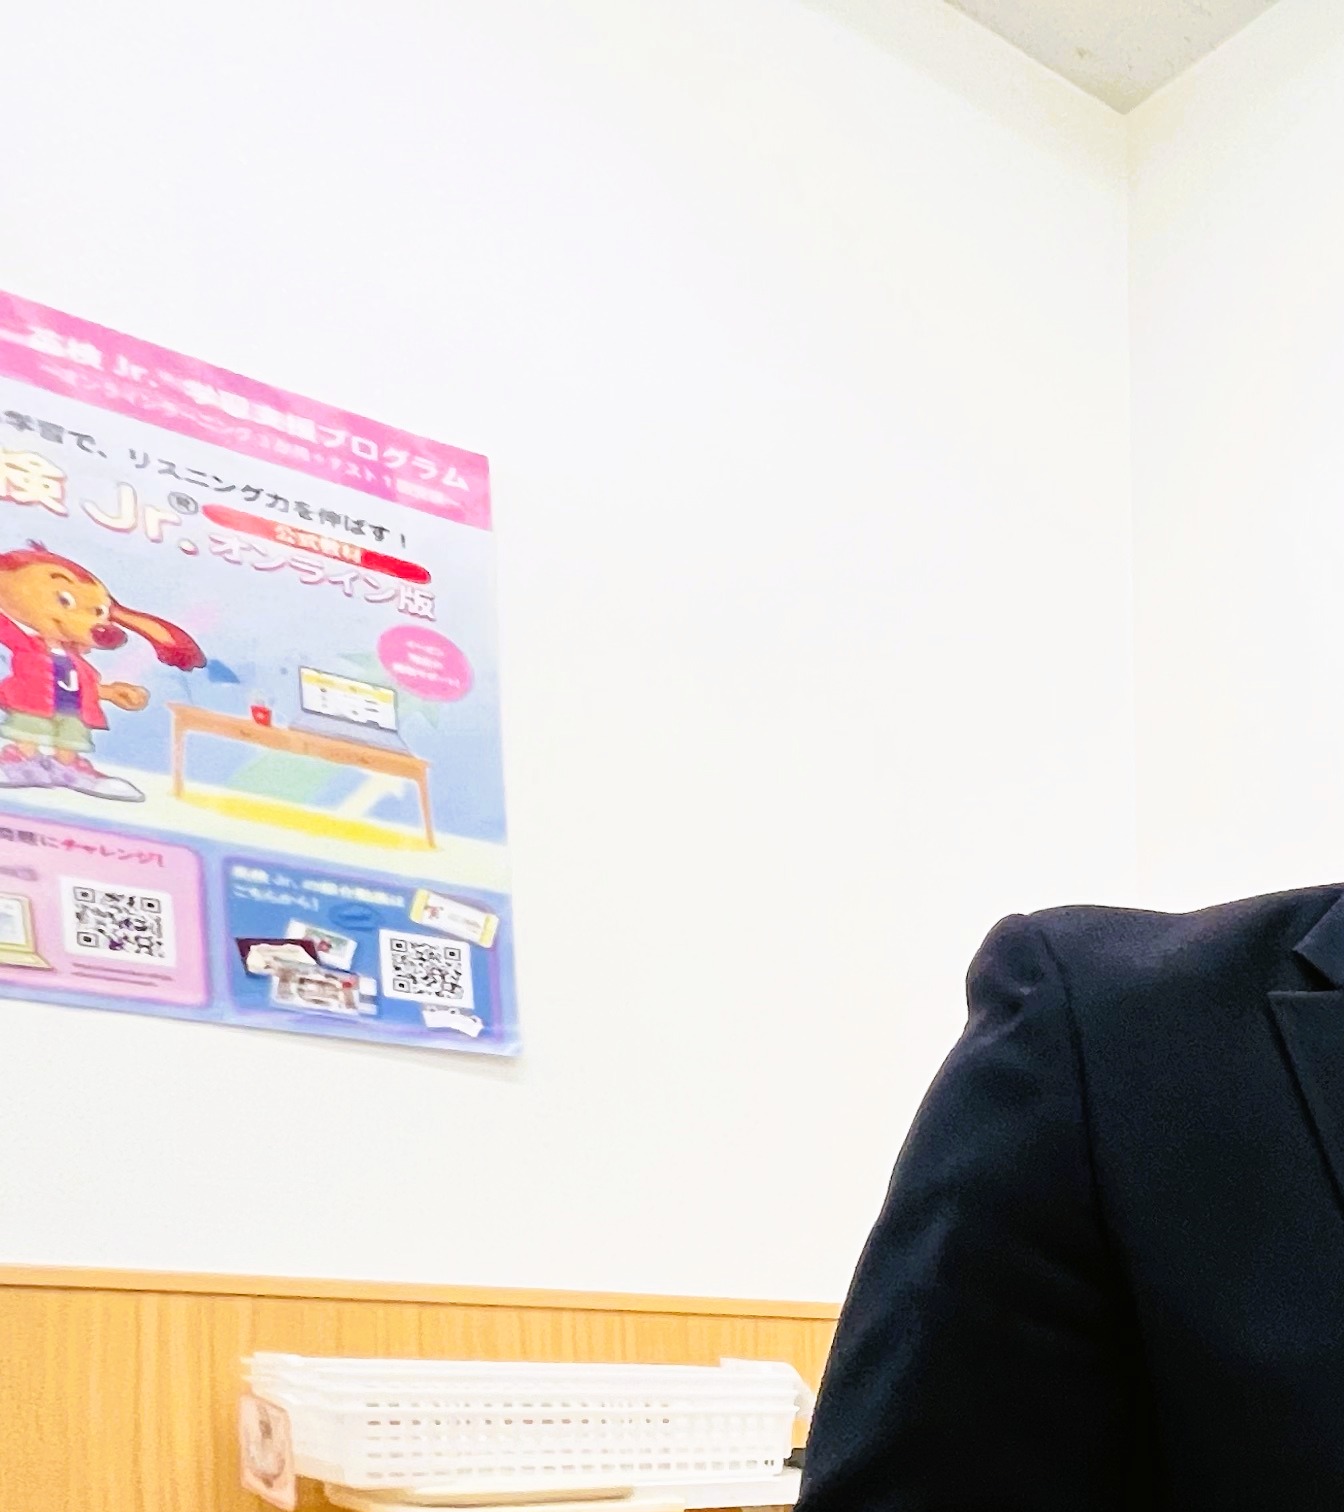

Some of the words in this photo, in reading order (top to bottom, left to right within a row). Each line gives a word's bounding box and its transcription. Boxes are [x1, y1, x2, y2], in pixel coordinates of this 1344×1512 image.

[207, 531, 437, 622] オンライン版
